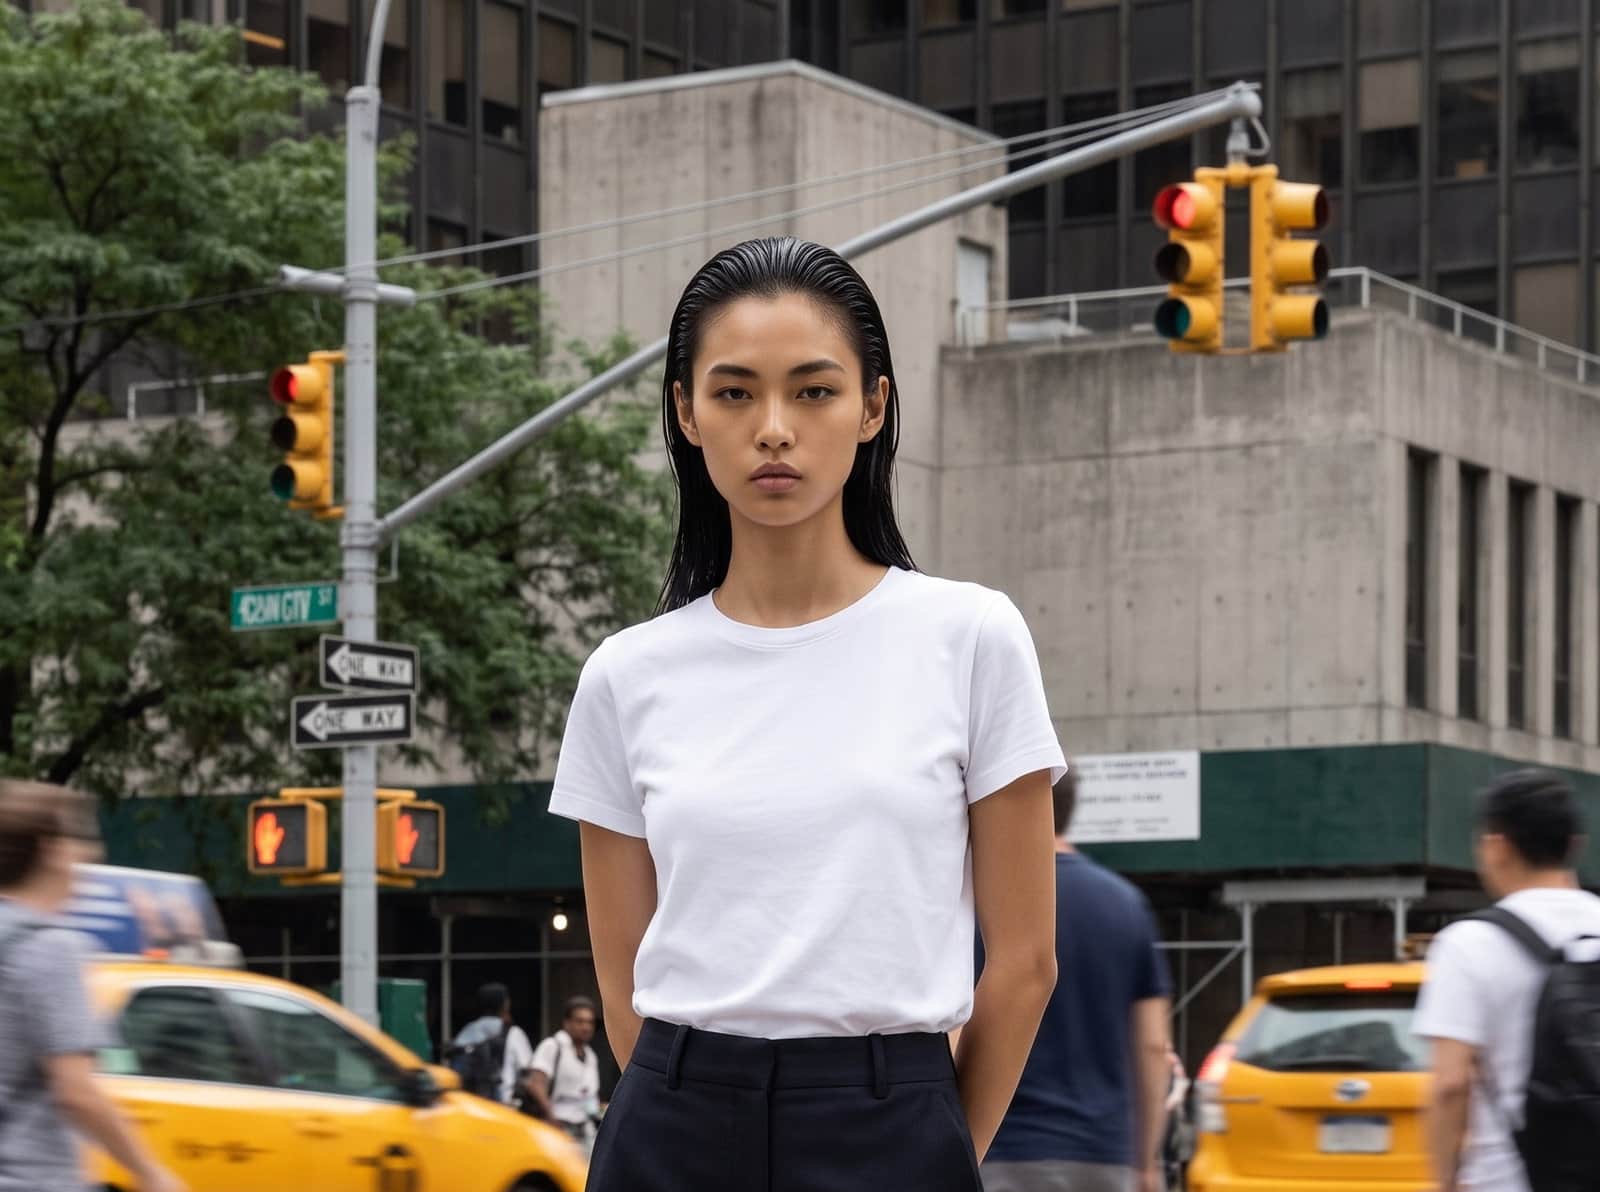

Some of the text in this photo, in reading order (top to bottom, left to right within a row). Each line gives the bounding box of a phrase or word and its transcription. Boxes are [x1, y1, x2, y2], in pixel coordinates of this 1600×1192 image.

[338, 654, 405, 676] ONE WAY
[312, 709, 398, 731] ONE WAY
